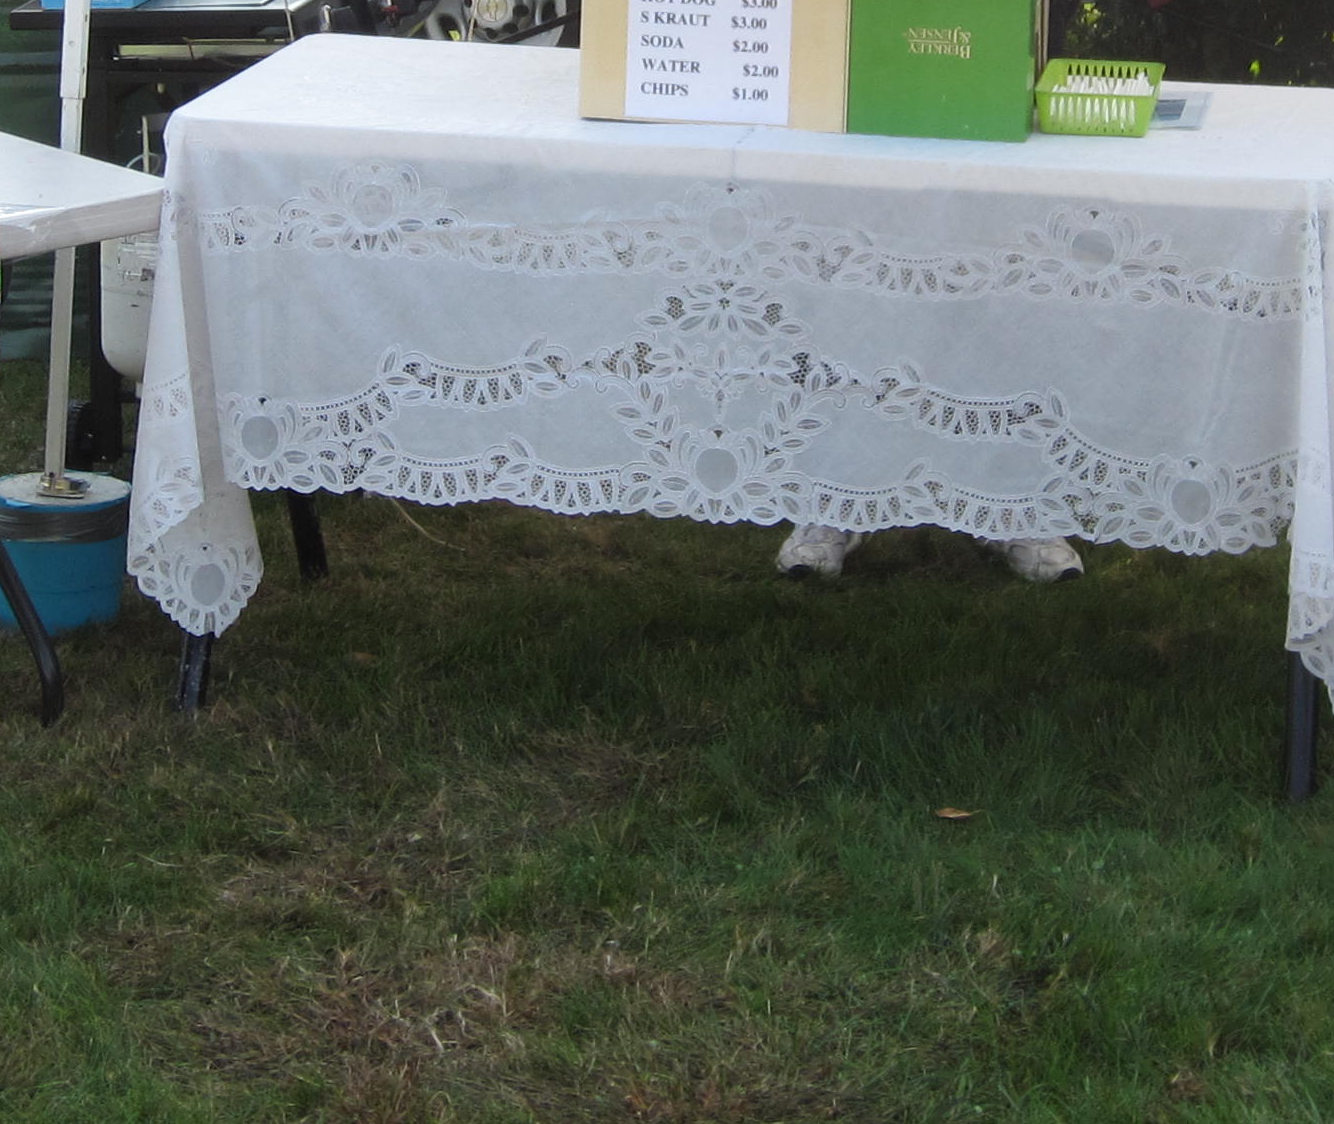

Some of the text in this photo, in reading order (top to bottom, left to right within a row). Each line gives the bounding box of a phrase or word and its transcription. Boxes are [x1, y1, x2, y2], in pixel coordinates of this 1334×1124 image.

[640, 11, 767, 29] S KRAUT $3.00
[640, 34, 768, 53] SODA $2.00
[908, 42, 971, 60] BERKLEY
[641, 58, 779, 78] WATER $2.00
[640, 81, 768, 101] CHIPS $1.00
